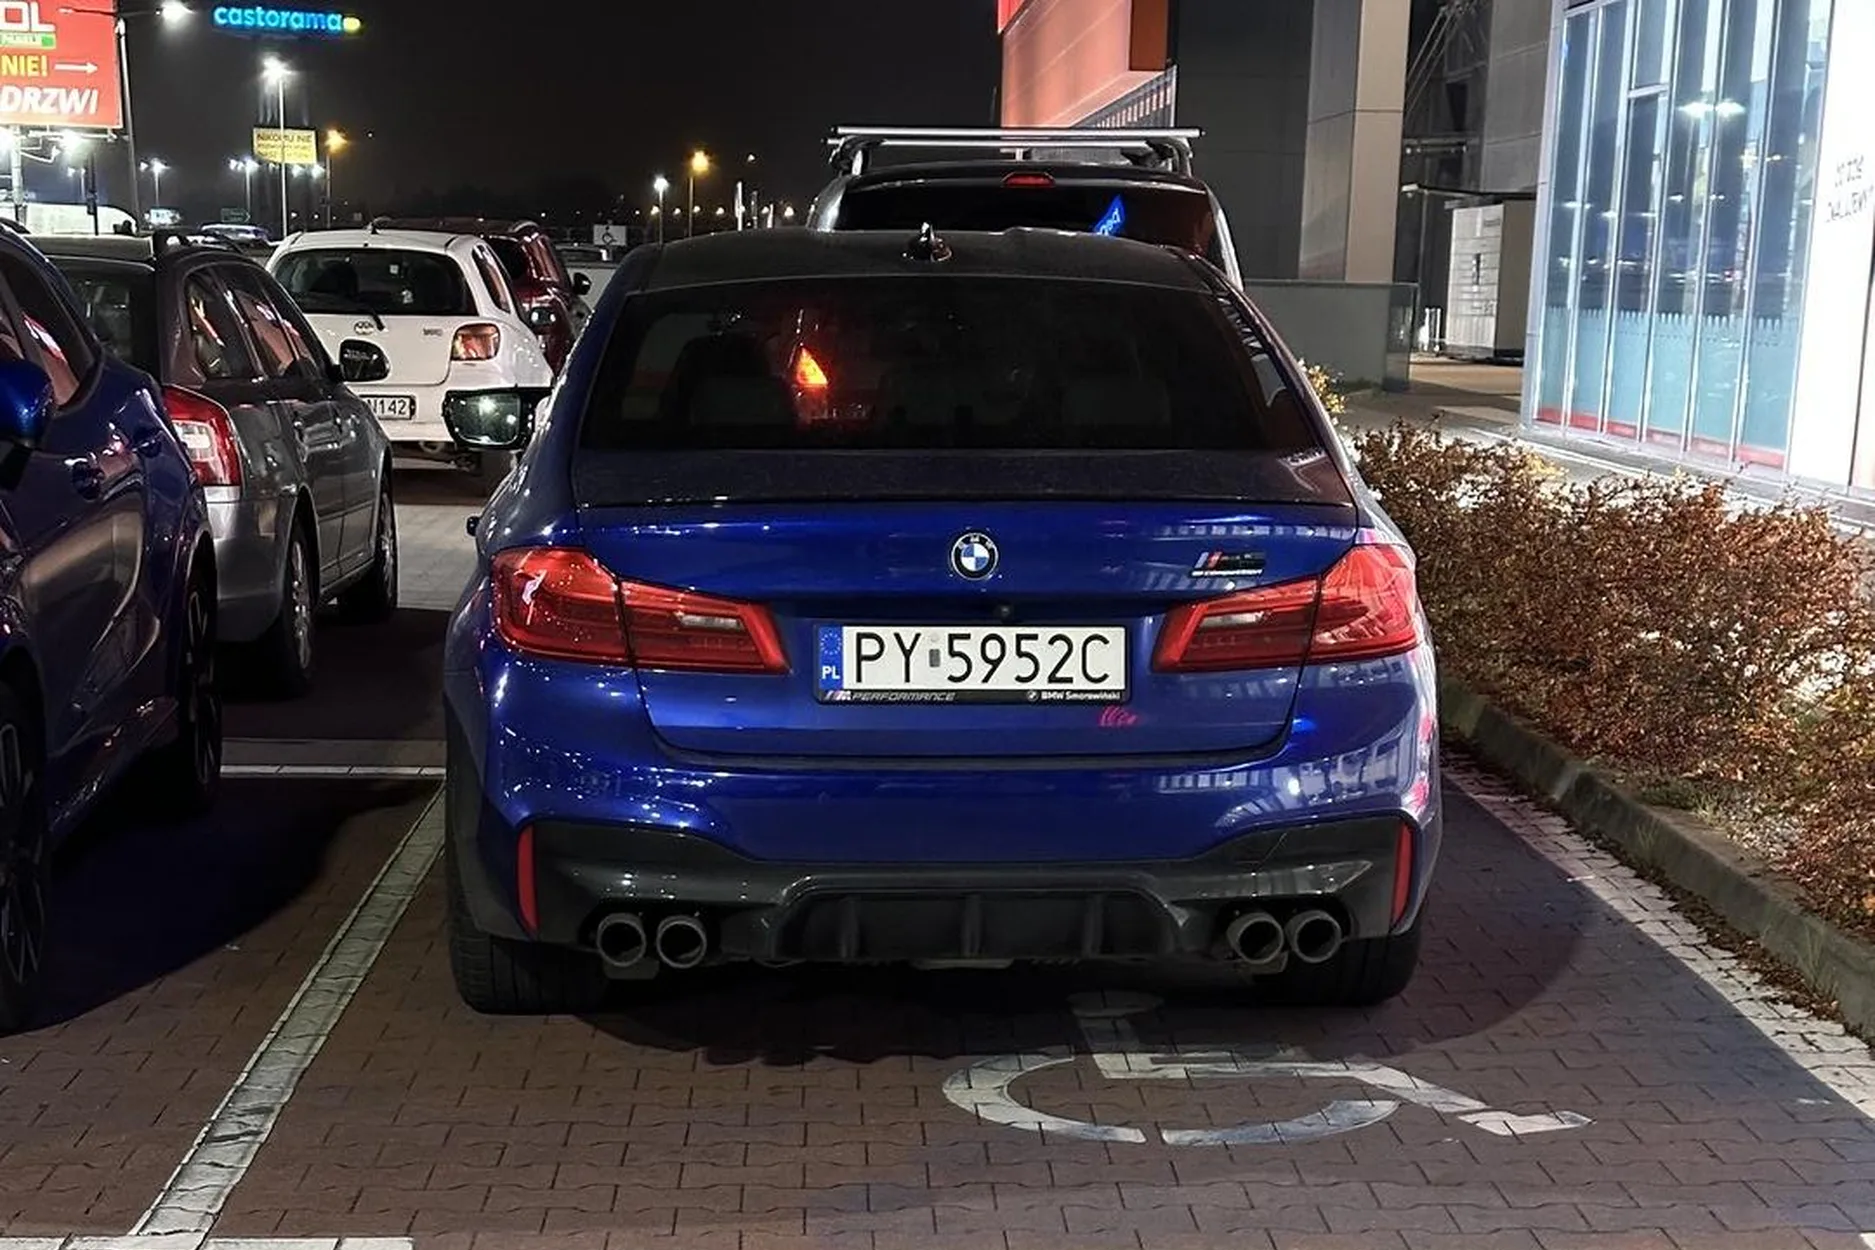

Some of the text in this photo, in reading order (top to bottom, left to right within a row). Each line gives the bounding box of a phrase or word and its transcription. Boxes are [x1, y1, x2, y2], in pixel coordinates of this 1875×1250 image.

[214, 6, 342, 31] castorama
[1, 54, 48, 77] NIE!
[0, 85, 99, 114] DRZWI
[855, 632, 1110, 684] PY 5952C
[821, 666, 840, 680] PL
[852, 691, 956, 701] PERFORMANCE
[1041, 690, 1065, 700] BMW
